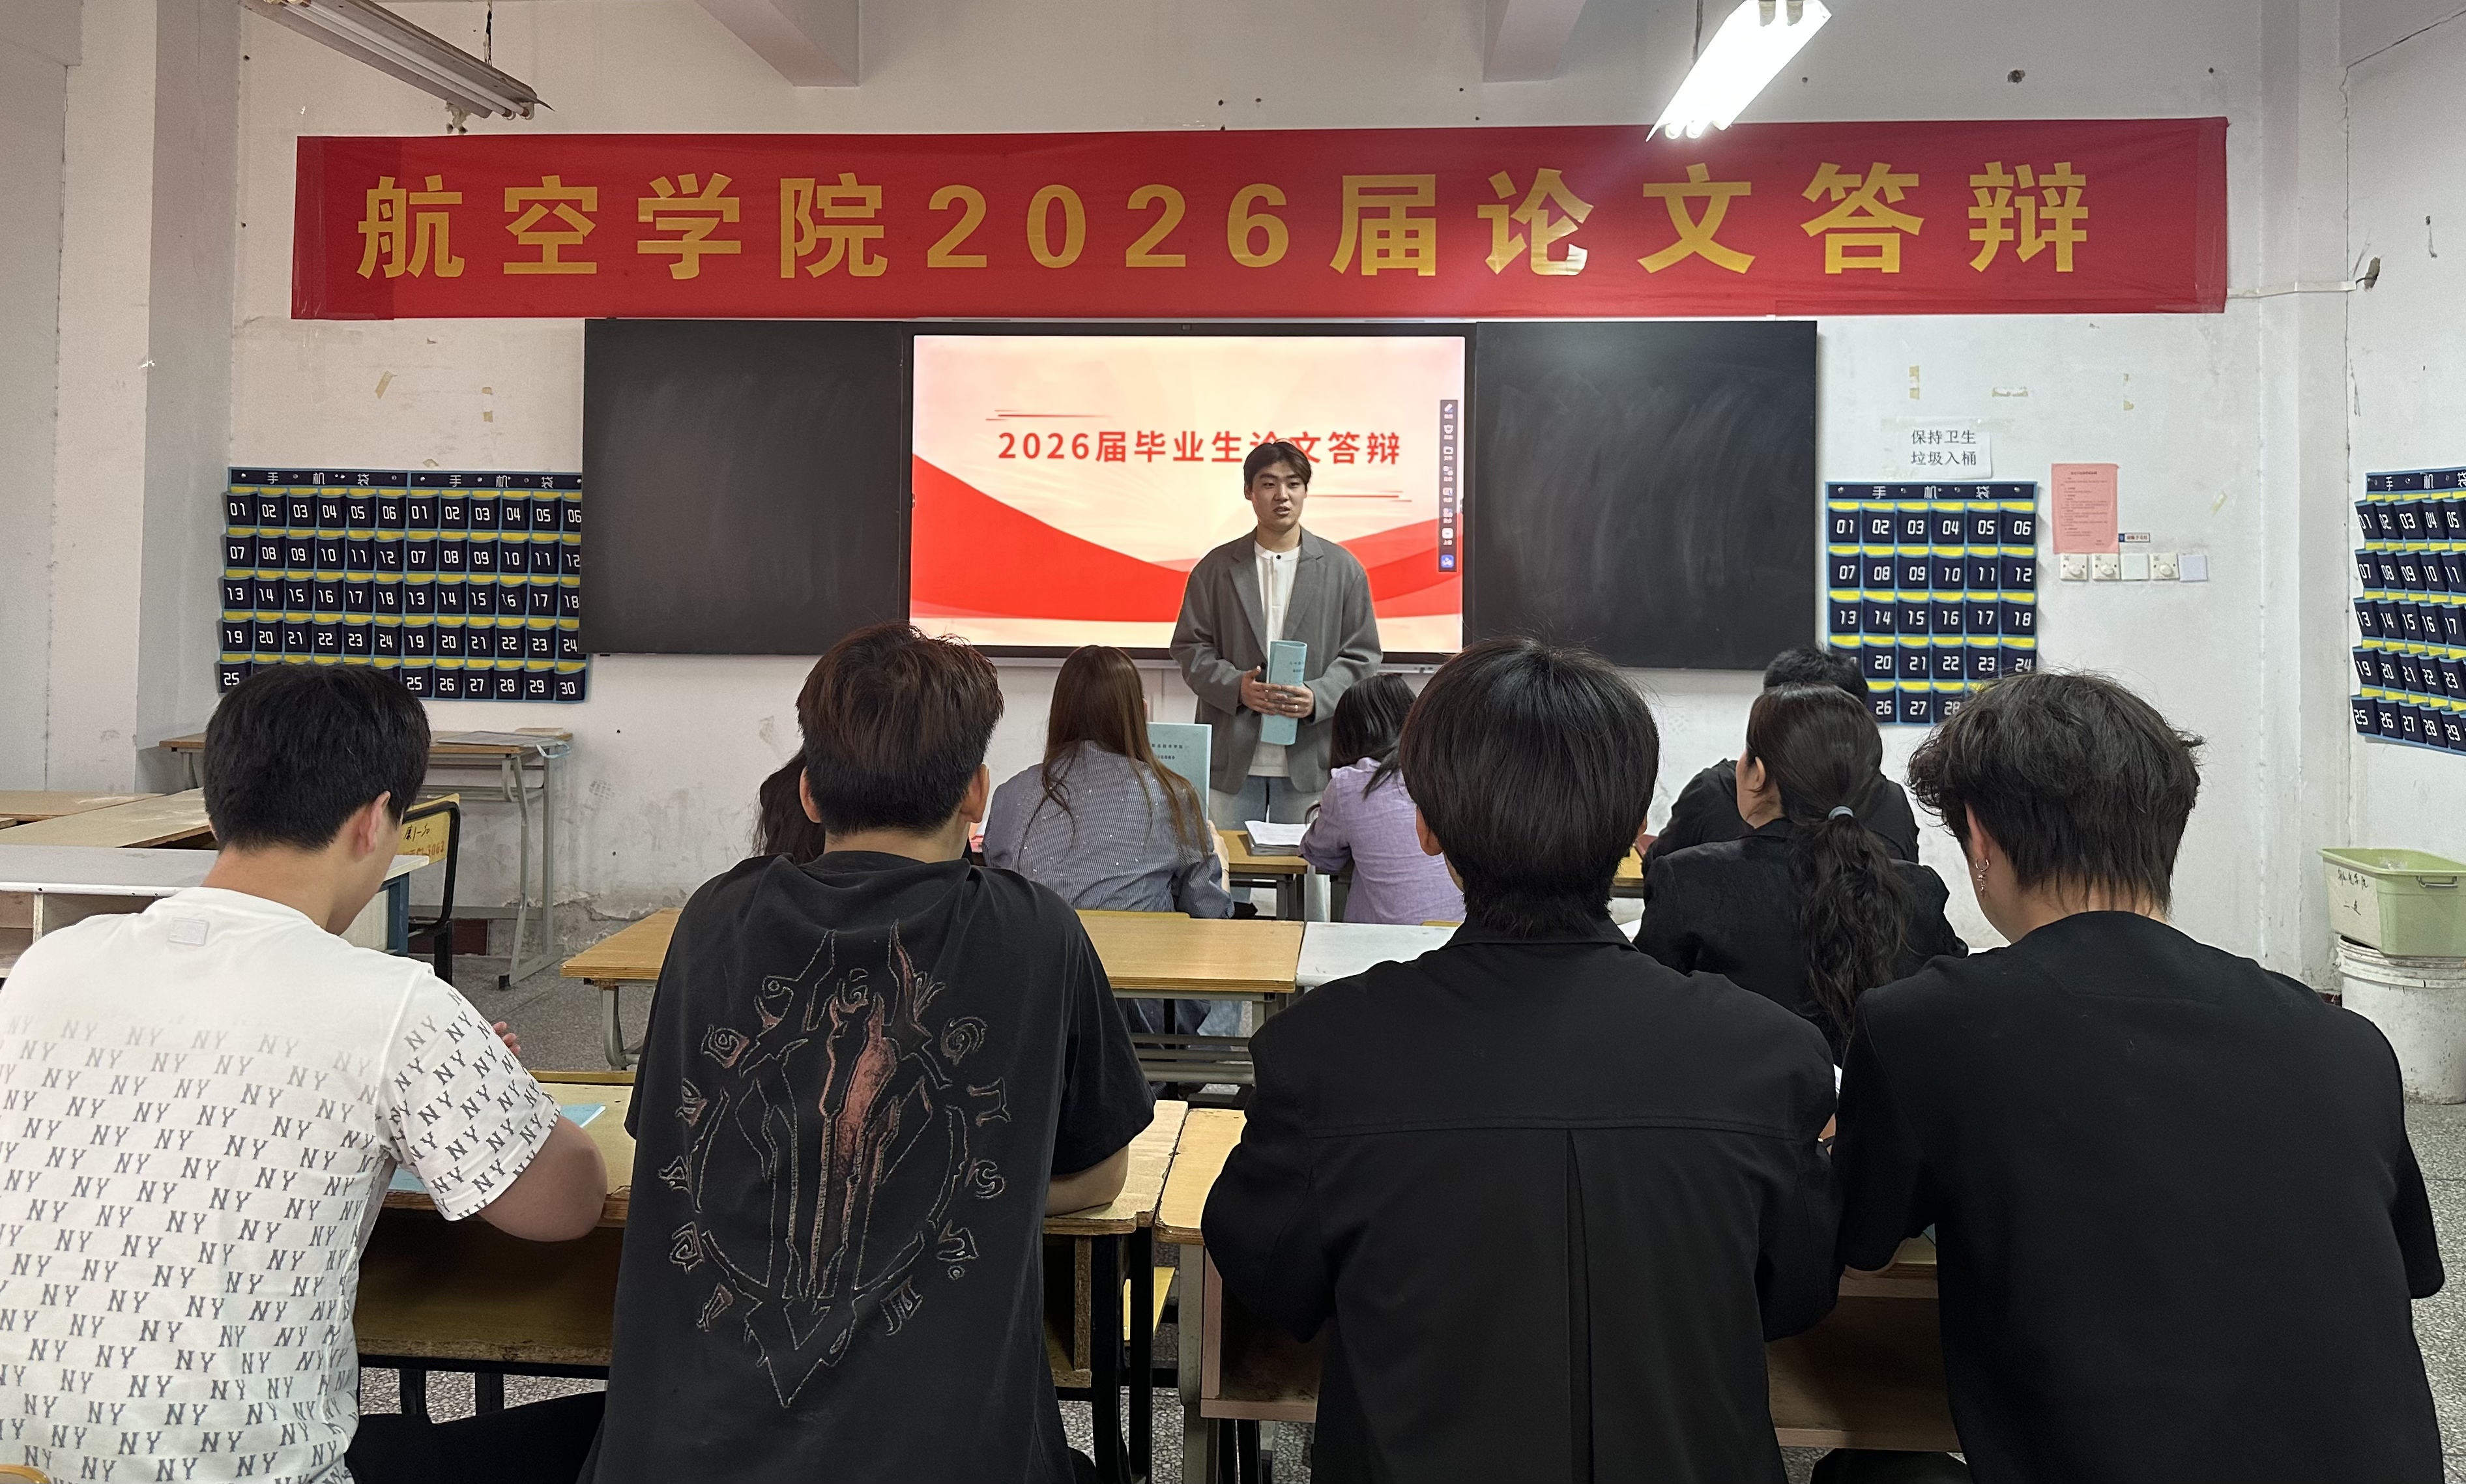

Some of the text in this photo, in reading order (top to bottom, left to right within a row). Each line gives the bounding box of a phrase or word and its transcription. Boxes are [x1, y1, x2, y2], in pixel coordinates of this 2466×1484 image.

[357, 161, 2089, 280] 航空学院2026届论文答辩
[1911, 429, 1976, 444] 保持卫生
[1911, 450, 1976, 466] 垃圾入桶
[229, 502, 397, 520] 01 02 03 04 05 06
[411, 506, 582, 523] 01 02 03 04 05 06
[2357, 511, 2460, 530] 01 02 03 04 05
[1836, 519, 2031, 536] 01 02 03 04 05 06
[230, 546, 396, 564] 07 08 09 10 11 12
[411, 550, 581, 568] 07 08 09 10 11 12
[1839, 564, 2032, 582] 07 08 09 10 11 12
[2358, 563, 2460, 583] 07 08 09 10 11
[227, 587, 394, 605] 13 14 15 16 17 18
[409, 592, 579, 609] 13 14 15 16 17 18
[1840, 610, 2031, 626] 13 14 15 16 17 18
[2357, 611, 2457, 635] 13 14 15 16 17
[226, 630, 393, 648] 19 20 21 22 23 24
[408, 635, 577, 652] 19 20 21 22 23 24
[1874, 655, 1892, 670] 20
[1909, 656, 1926, 671] 21
[1942, 656, 1960, 671] 22
[1978, 656, 1995, 671] 23
[2014, 658, 2031, 673] 24
[2356, 660, 2459, 689] 19 20 21 22 23
[223, 672, 240, 686] 25
[406, 677, 576, 695] 25 26 27 28 29 30
[1876, 700, 1892, 715] 26
[1909, 701, 1927, 716] 27
[2353, 708, 2461, 742] 25 26 27 28 29
[445, 1011, 472, 1044] NY
[433, 1049, 466, 1086] NY
[240, 1083, 283, 1108] NY
[459, 1084, 491, 1120] NY
[497, 1079, 520, 1114] NY
[196, 1105, 238, 1128] NY
[417, 1090, 453, 1126] NY
[154, 1129, 194, 1150] NY
[224, 1135, 268, 1160] NY
[445, 1124, 480, 1161] NY
[486, 1118, 515, 1154] NY
[181, 1157, 221, 1181] NY
[431, 1166, 465, 1194] NY
[472, 1158, 506, 1195] NY
[71, 1176, 110, 1199] NY
[136, 1180, 178, 1204] NY
[26, 1199, 68, 1223] NY
[209, 1187, 252, 1212] NY
[283, 1198, 321, 1221] NY
[166, 1210, 207, 1234] NY
[237, 1219, 282, 1243] NY
[121, 1234, 164, 1258] NY
[81, 1259, 119, 1283] NY
[266, 1249, 306, 1271] NY
[152, 1265, 196, 1288] NY
[107, 1289, 150, 1313] NY
[185, 1295, 225, 1320] NY
[139, 1320, 183, 1343] NY
[175, 1349, 216, 1373] NY
[127, 1375, 173, 1398] NY
[117, 1431, 163, 1455] NY
[199, 1431, 244, 1453] NY
[235, 1451, 278, 1478] NY
